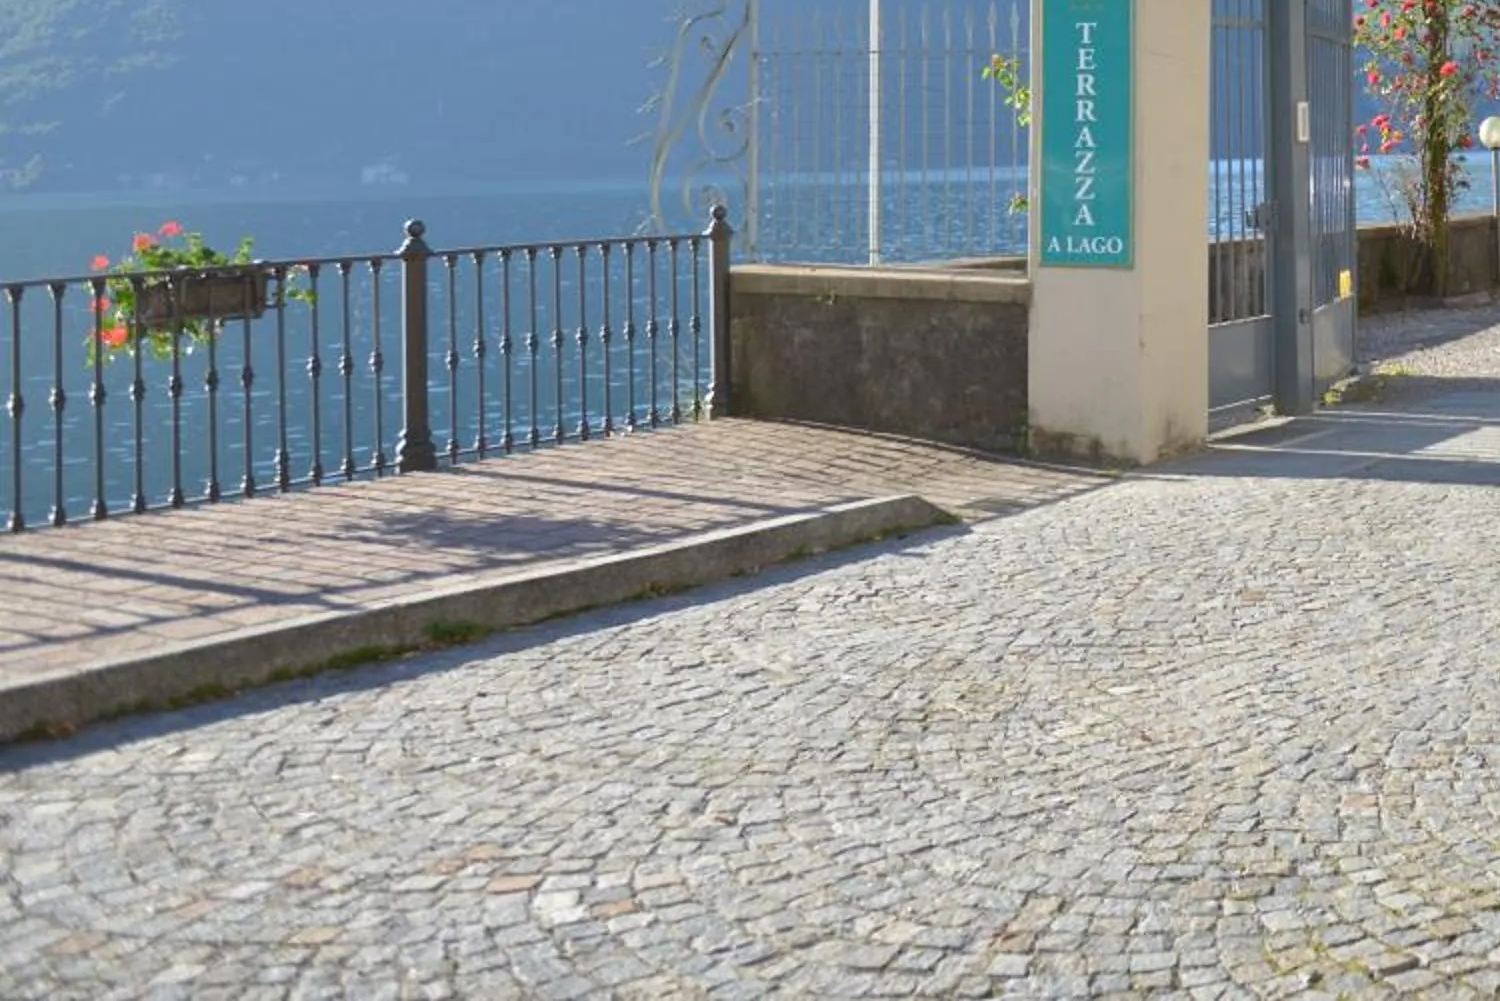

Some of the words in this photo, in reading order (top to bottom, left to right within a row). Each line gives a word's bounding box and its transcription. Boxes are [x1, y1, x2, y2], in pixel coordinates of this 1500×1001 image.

[1073, 21, 1098, 227] TERRAZZA
[1047, 236, 1061, 253] A
[1066, 235, 1124, 254] LAGO
